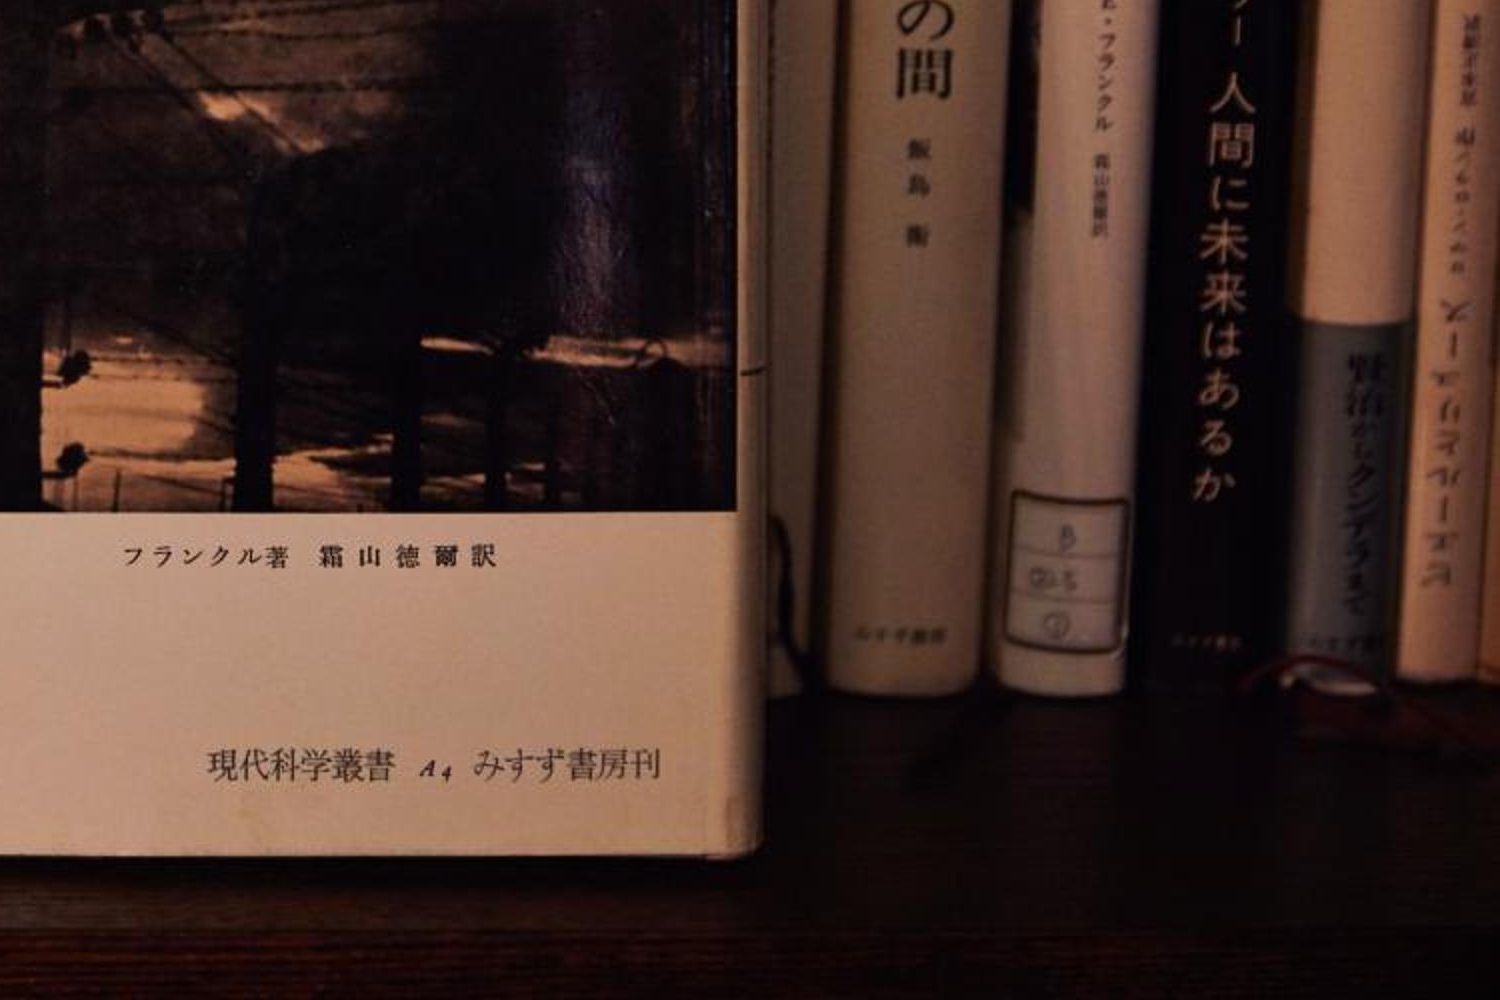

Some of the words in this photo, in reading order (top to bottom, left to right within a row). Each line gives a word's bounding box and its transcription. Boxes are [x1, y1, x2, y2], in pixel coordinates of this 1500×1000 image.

[1190, 71, 1258, 503] 人間に未来はあるか
[122, 546, 289, 569] フランクル著
[319, 544, 497, 569] 霜山徳爾訳
[207, 747, 396, 783] 現代科学叢書
[473, 746, 662, 782] みすず書房刊
